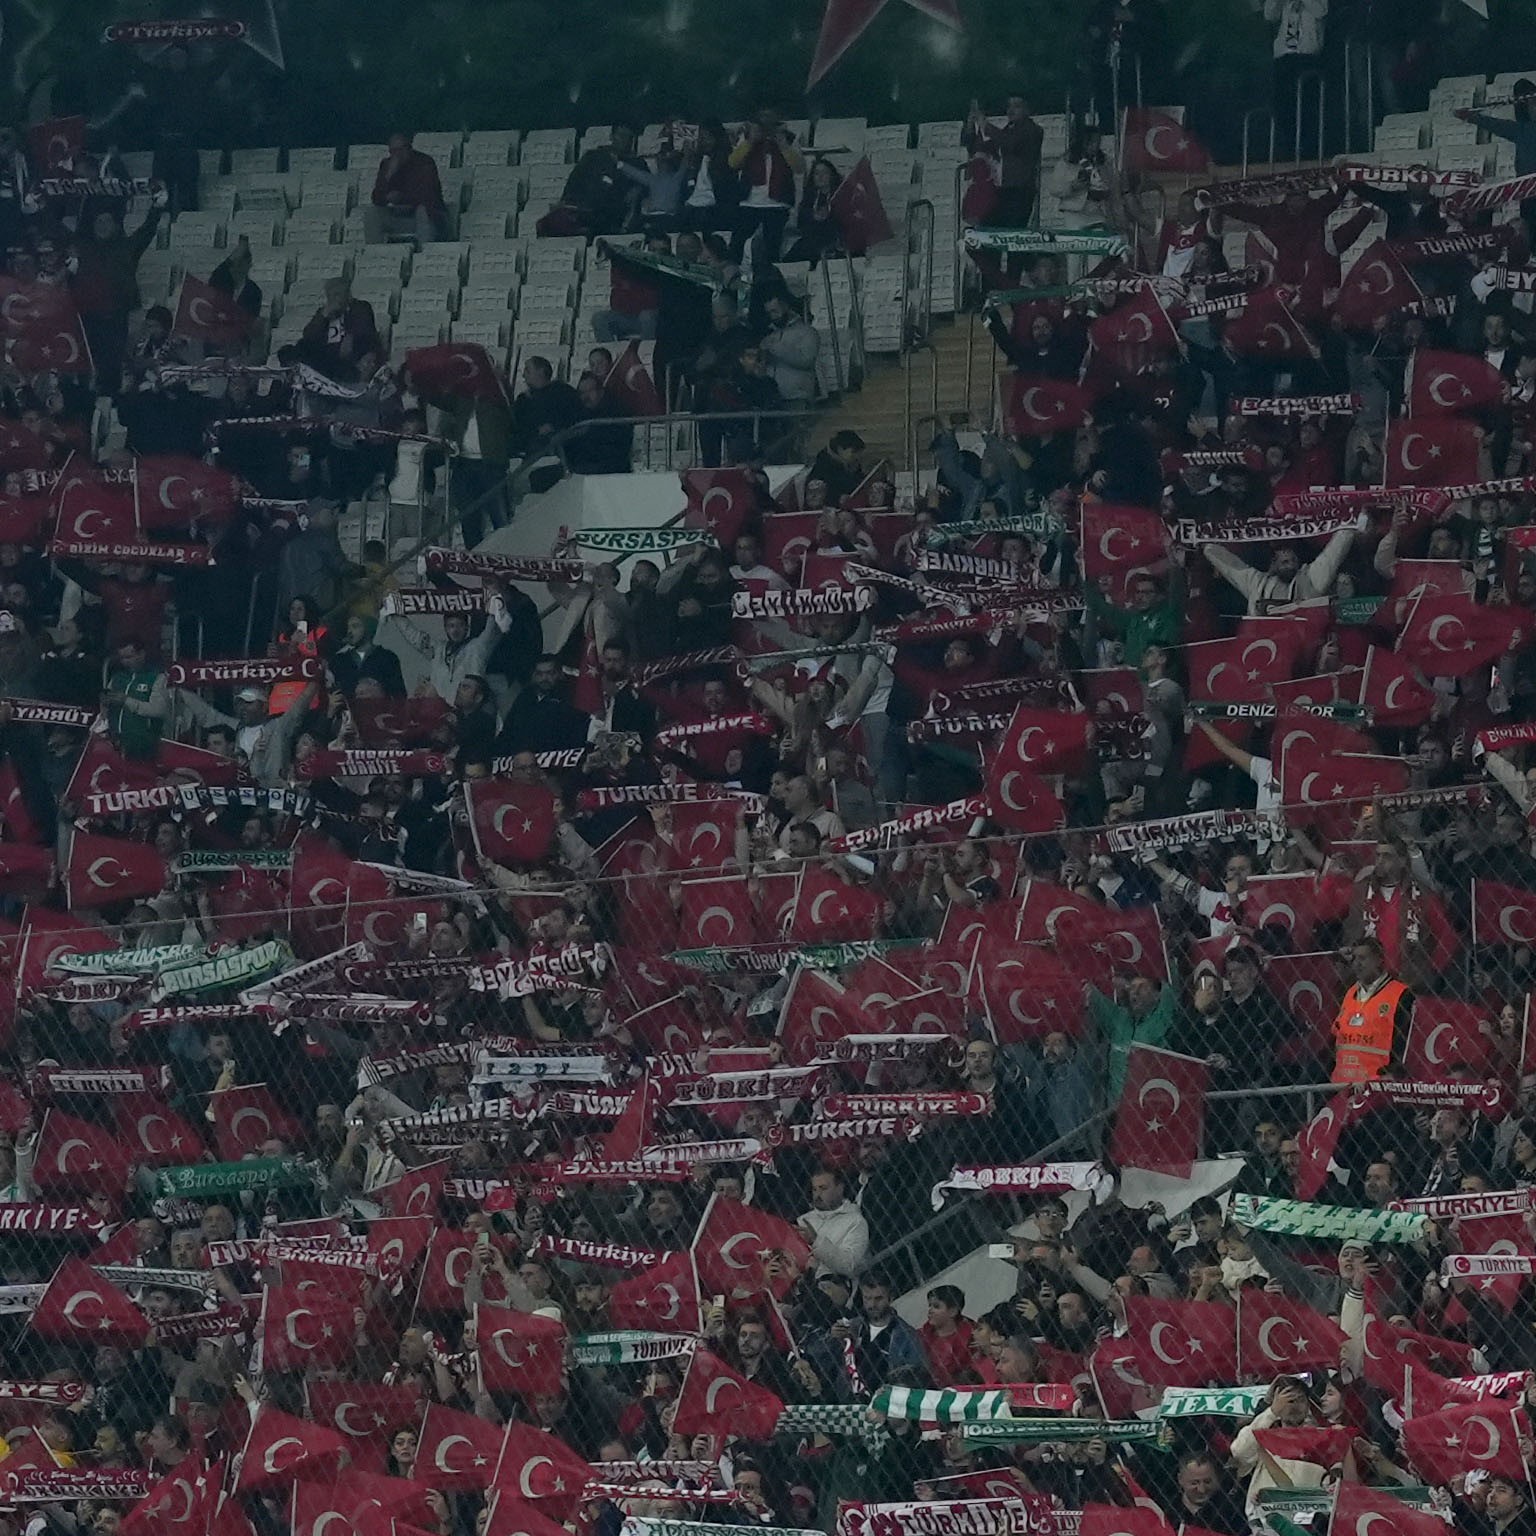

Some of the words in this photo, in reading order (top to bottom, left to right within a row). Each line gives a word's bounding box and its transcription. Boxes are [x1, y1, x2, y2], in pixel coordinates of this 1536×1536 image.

[192, 662, 294, 681] Türkiye
[594, 782, 697, 805] TÜRKİYE
[791, 1119, 894, 1138] TÜRKİYE
[559, 1238, 656, 1262] Türkiye
